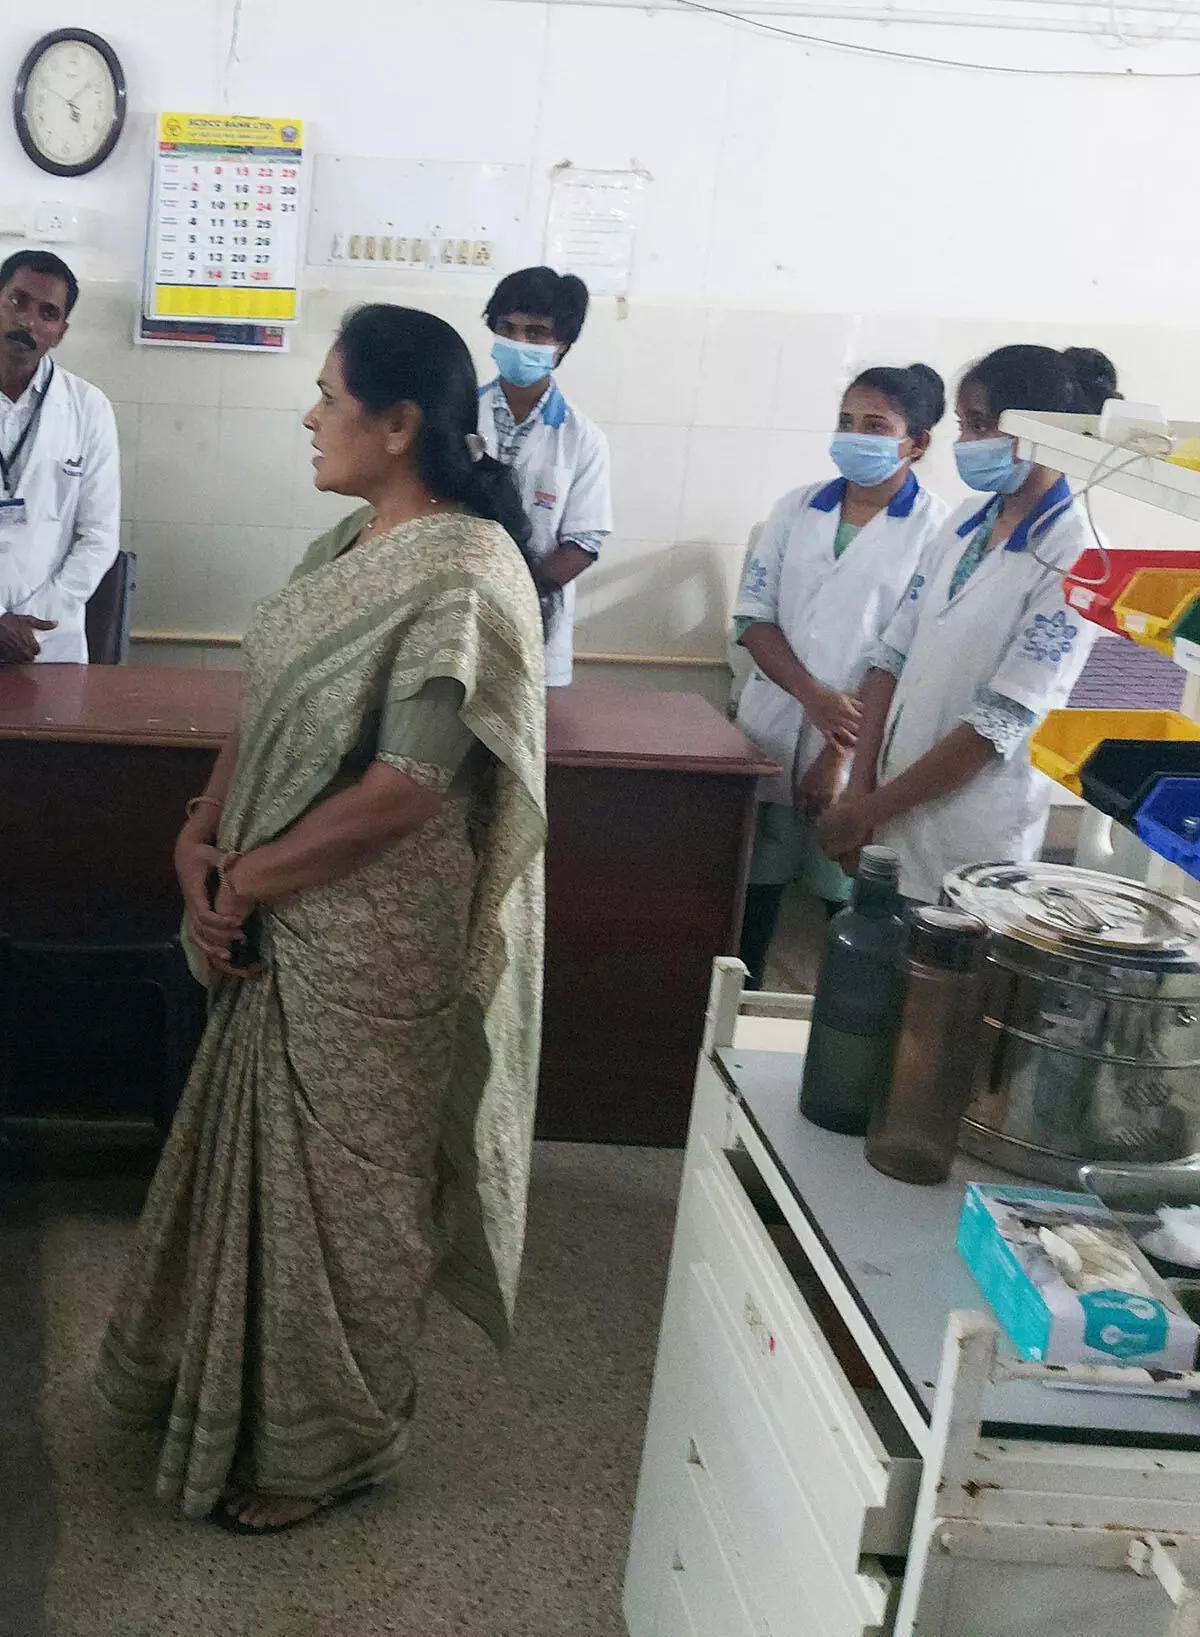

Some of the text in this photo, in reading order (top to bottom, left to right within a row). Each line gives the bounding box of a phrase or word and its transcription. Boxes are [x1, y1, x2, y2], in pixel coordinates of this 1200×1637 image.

[257, 167, 274, 178] 22
[281, 168, 297, 179] 29
[257, 184, 273, 195] 23
[280, 186, 297, 196] 30
[211, 200, 226, 210] 10
[234, 201, 249, 210] 17
[281, 203, 296, 213] 31
[210, 218, 225, 227] 11
[233, 219, 248, 228] 18
[256, 219, 271, 229] 25
[209, 235, 225, 245] 12
[233, 236, 247, 246] 19
[255, 236, 271, 246] 26
[209, 252, 223, 263] 13
[231, 253, 247, 263] 20
[255, 254, 270, 264] 27
[207, 270, 223, 280] 14
[231, 271, 245, 280] 21
